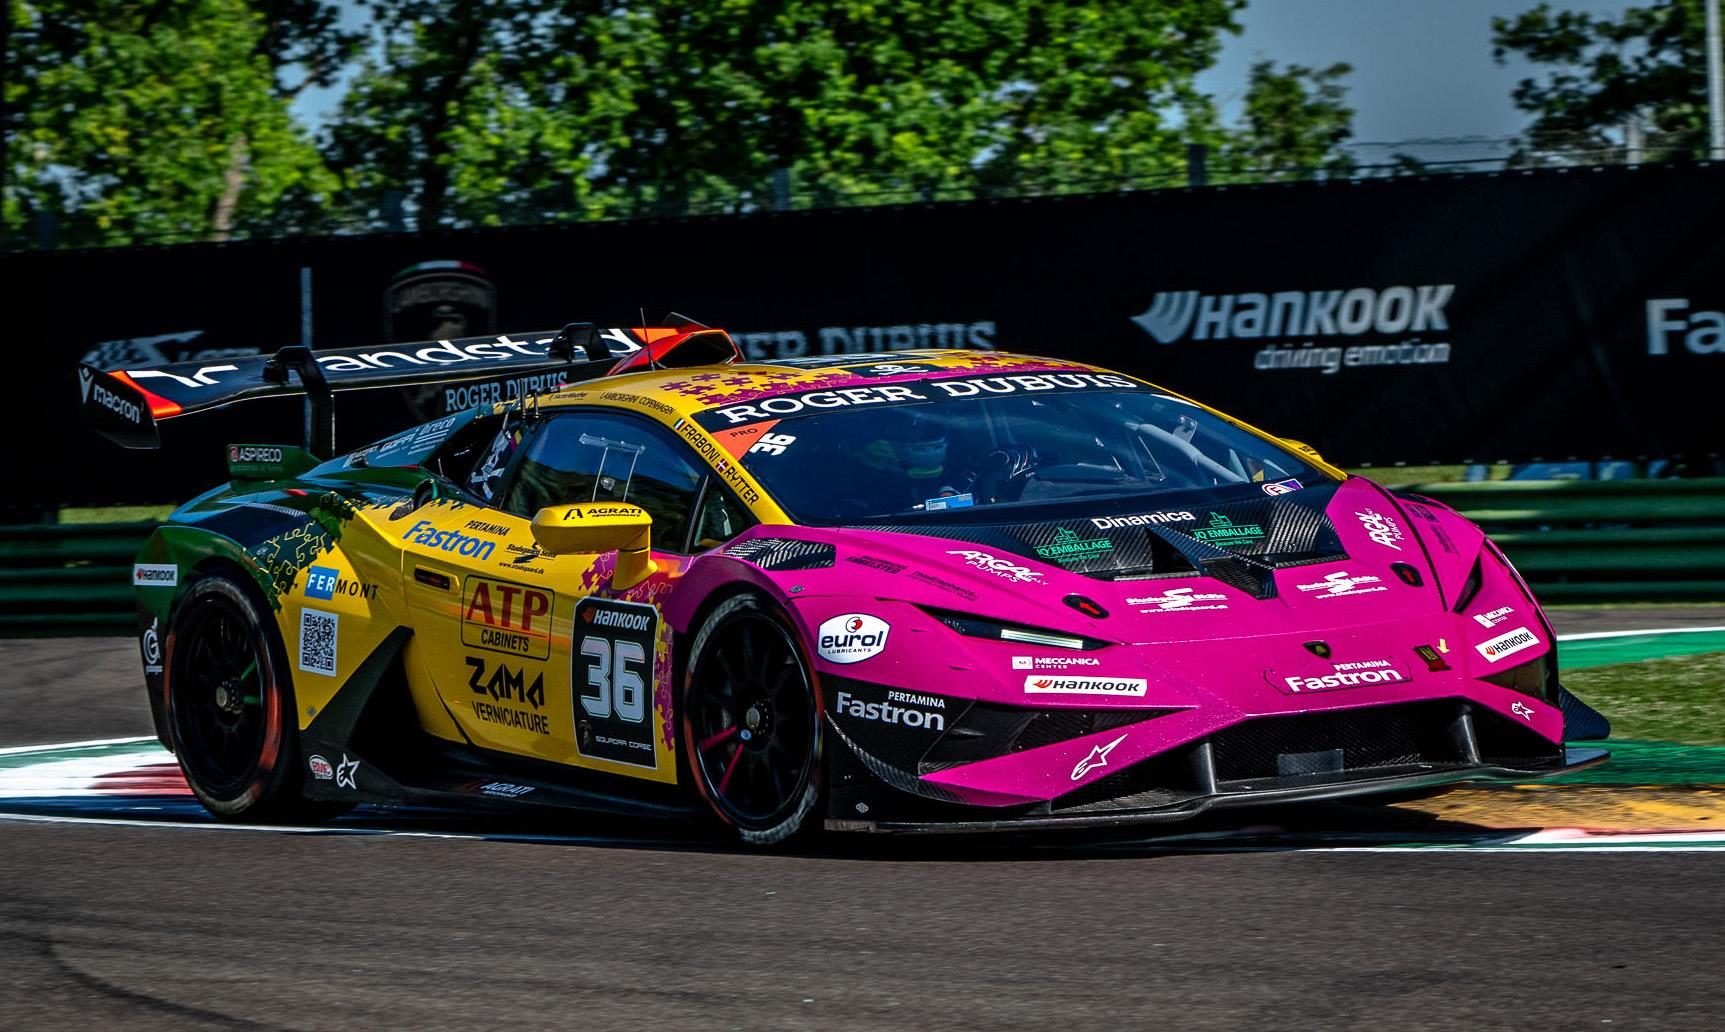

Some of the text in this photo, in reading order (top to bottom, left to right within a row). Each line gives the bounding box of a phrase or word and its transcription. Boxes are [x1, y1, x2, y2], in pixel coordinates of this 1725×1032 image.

[1254, 339, 1451, 374] driving emotion
[93, 384, 141, 424] macron
[445, 381, 502, 413] ROGER
[717, 374, 1138, 424] ROGER DUBUIS
[681, 422, 721, 463] FRABONI
[730, 427, 758, 438] PRO
[750, 432, 798, 457] 36
[723, 467, 760, 506] RYTTER
[587, 508, 643, 517] AGRATI
[1091, 509, 1195, 530] Dinamica
[402, 520, 497, 561] Fastron
[464, 519, 512, 538] PERTAMINA
[1207, 524, 1264, 540] EMBALLAGE
[1051, 539, 1112, 556] EMBALLAGE
[307, 573, 379, 600] FERMONT
[466, 582, 548, 631] ATP
[481, 629, 530, 651] CABINETS
[821, 631, 883, 648] eurol
[1035, 657, 1100, 666] MECCANICA
[580, 635, 645, 724] 36
[1284, 668, 1403, 693] Fastron
[836, 691, 944, 731] Fastron
[888, 691, 946, 708] PERTAMINA
[472, 702, 550, 735] VERNICIATURE
